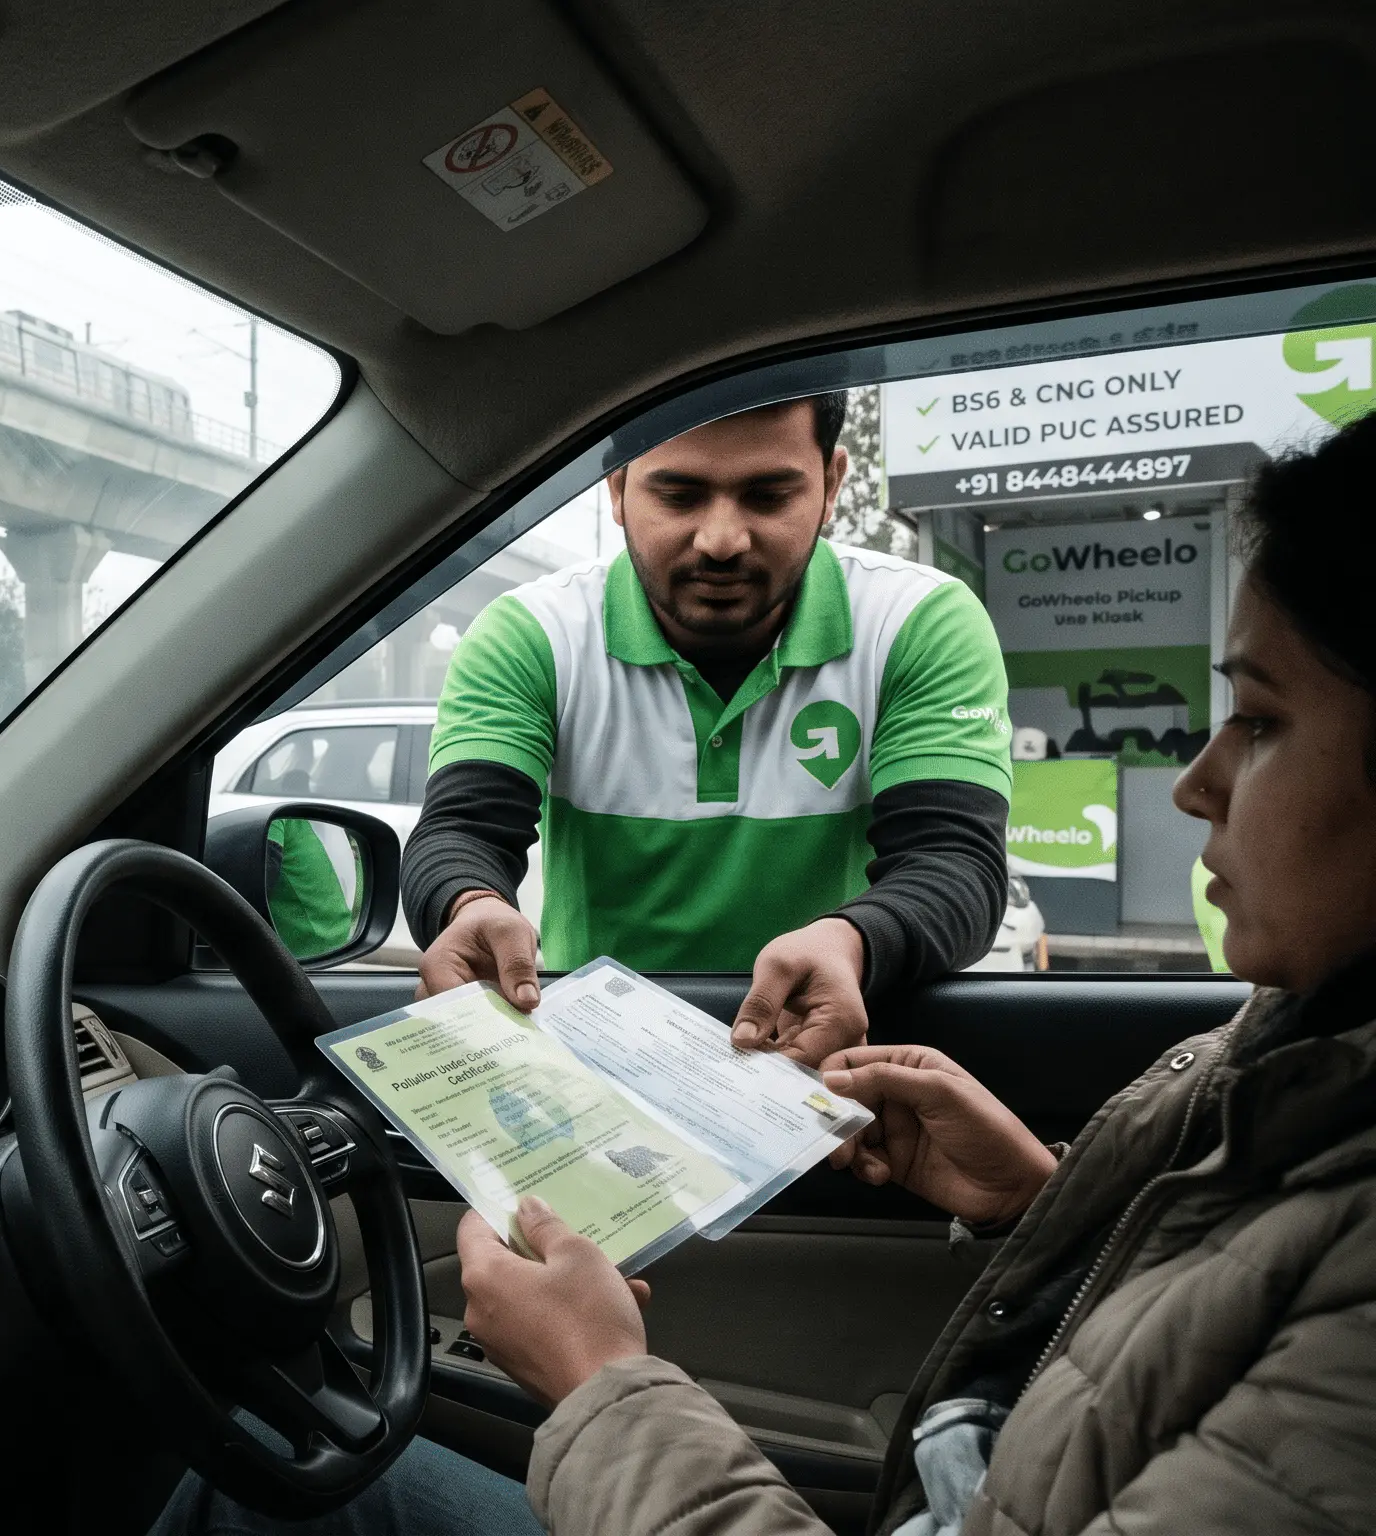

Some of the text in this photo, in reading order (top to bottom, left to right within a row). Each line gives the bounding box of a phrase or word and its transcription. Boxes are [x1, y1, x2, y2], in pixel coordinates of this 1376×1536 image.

[952, 368, 1182, 413] BS6 & CNG ONLY
[951, 404, 1244, 451] VALID PUC ASSURED
[955, 454, 1192, 496] +91 8448444897
[1002, 537, 1198, 574] GoWheelo
[1018, 588, 1182, 609] GoWheelo Pickup
[1006, 825, 1093, 846] Wheelo
